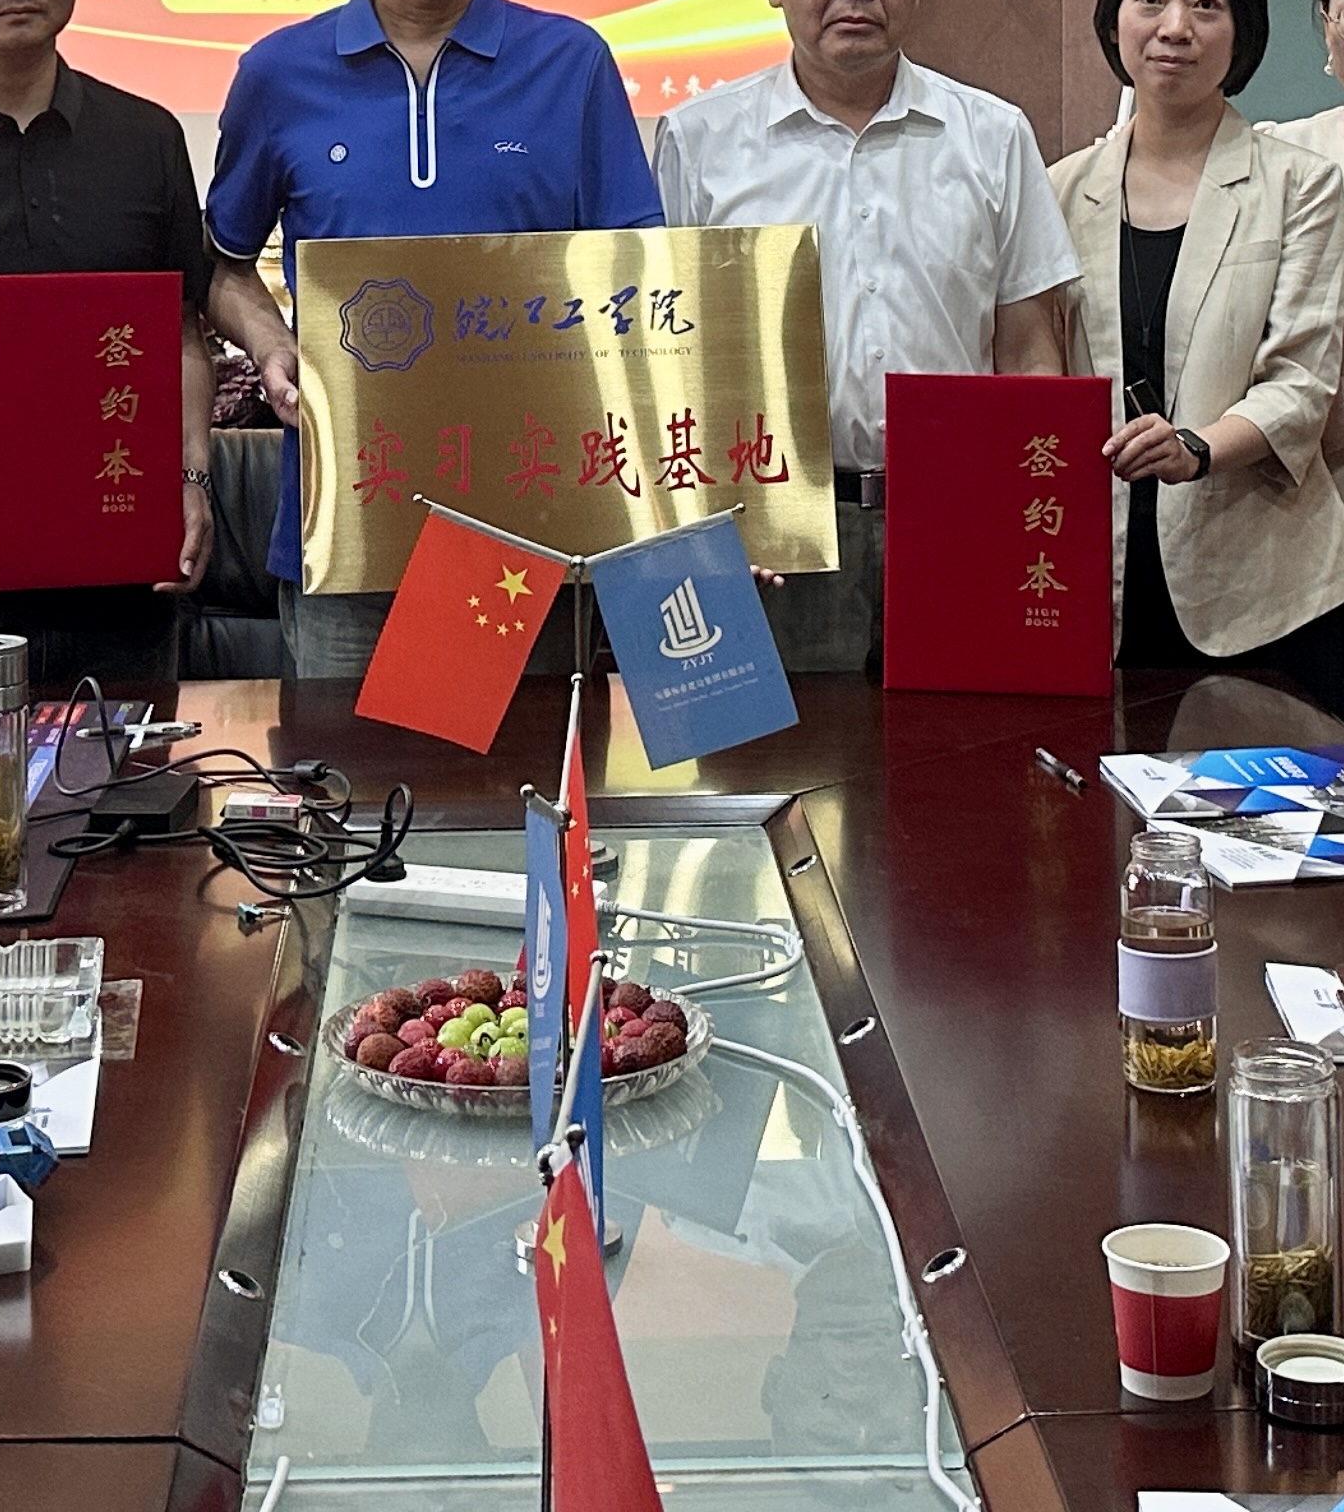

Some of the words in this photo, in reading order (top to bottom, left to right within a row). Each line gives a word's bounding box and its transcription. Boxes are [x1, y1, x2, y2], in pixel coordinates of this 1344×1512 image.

[452, 285, 695, 342] 皖江工学院
[594, 349, 610, 359] OF
[618, 346, 693, 359] TECHNOLOGY
[94, 323, 144, 484] 签约本
[352, 406, 792, 505] 实习实践基地
[103, 493, 136, 503] SIGN
[102, 504, 136, 513] BOOK
[1018, 434, 1069, 599] 签约本
[1026, 607, 1060, 617] SIGN
[1025, 618, 1060, 627] BOOK
[681, 652, 714, 671] ZYJT
